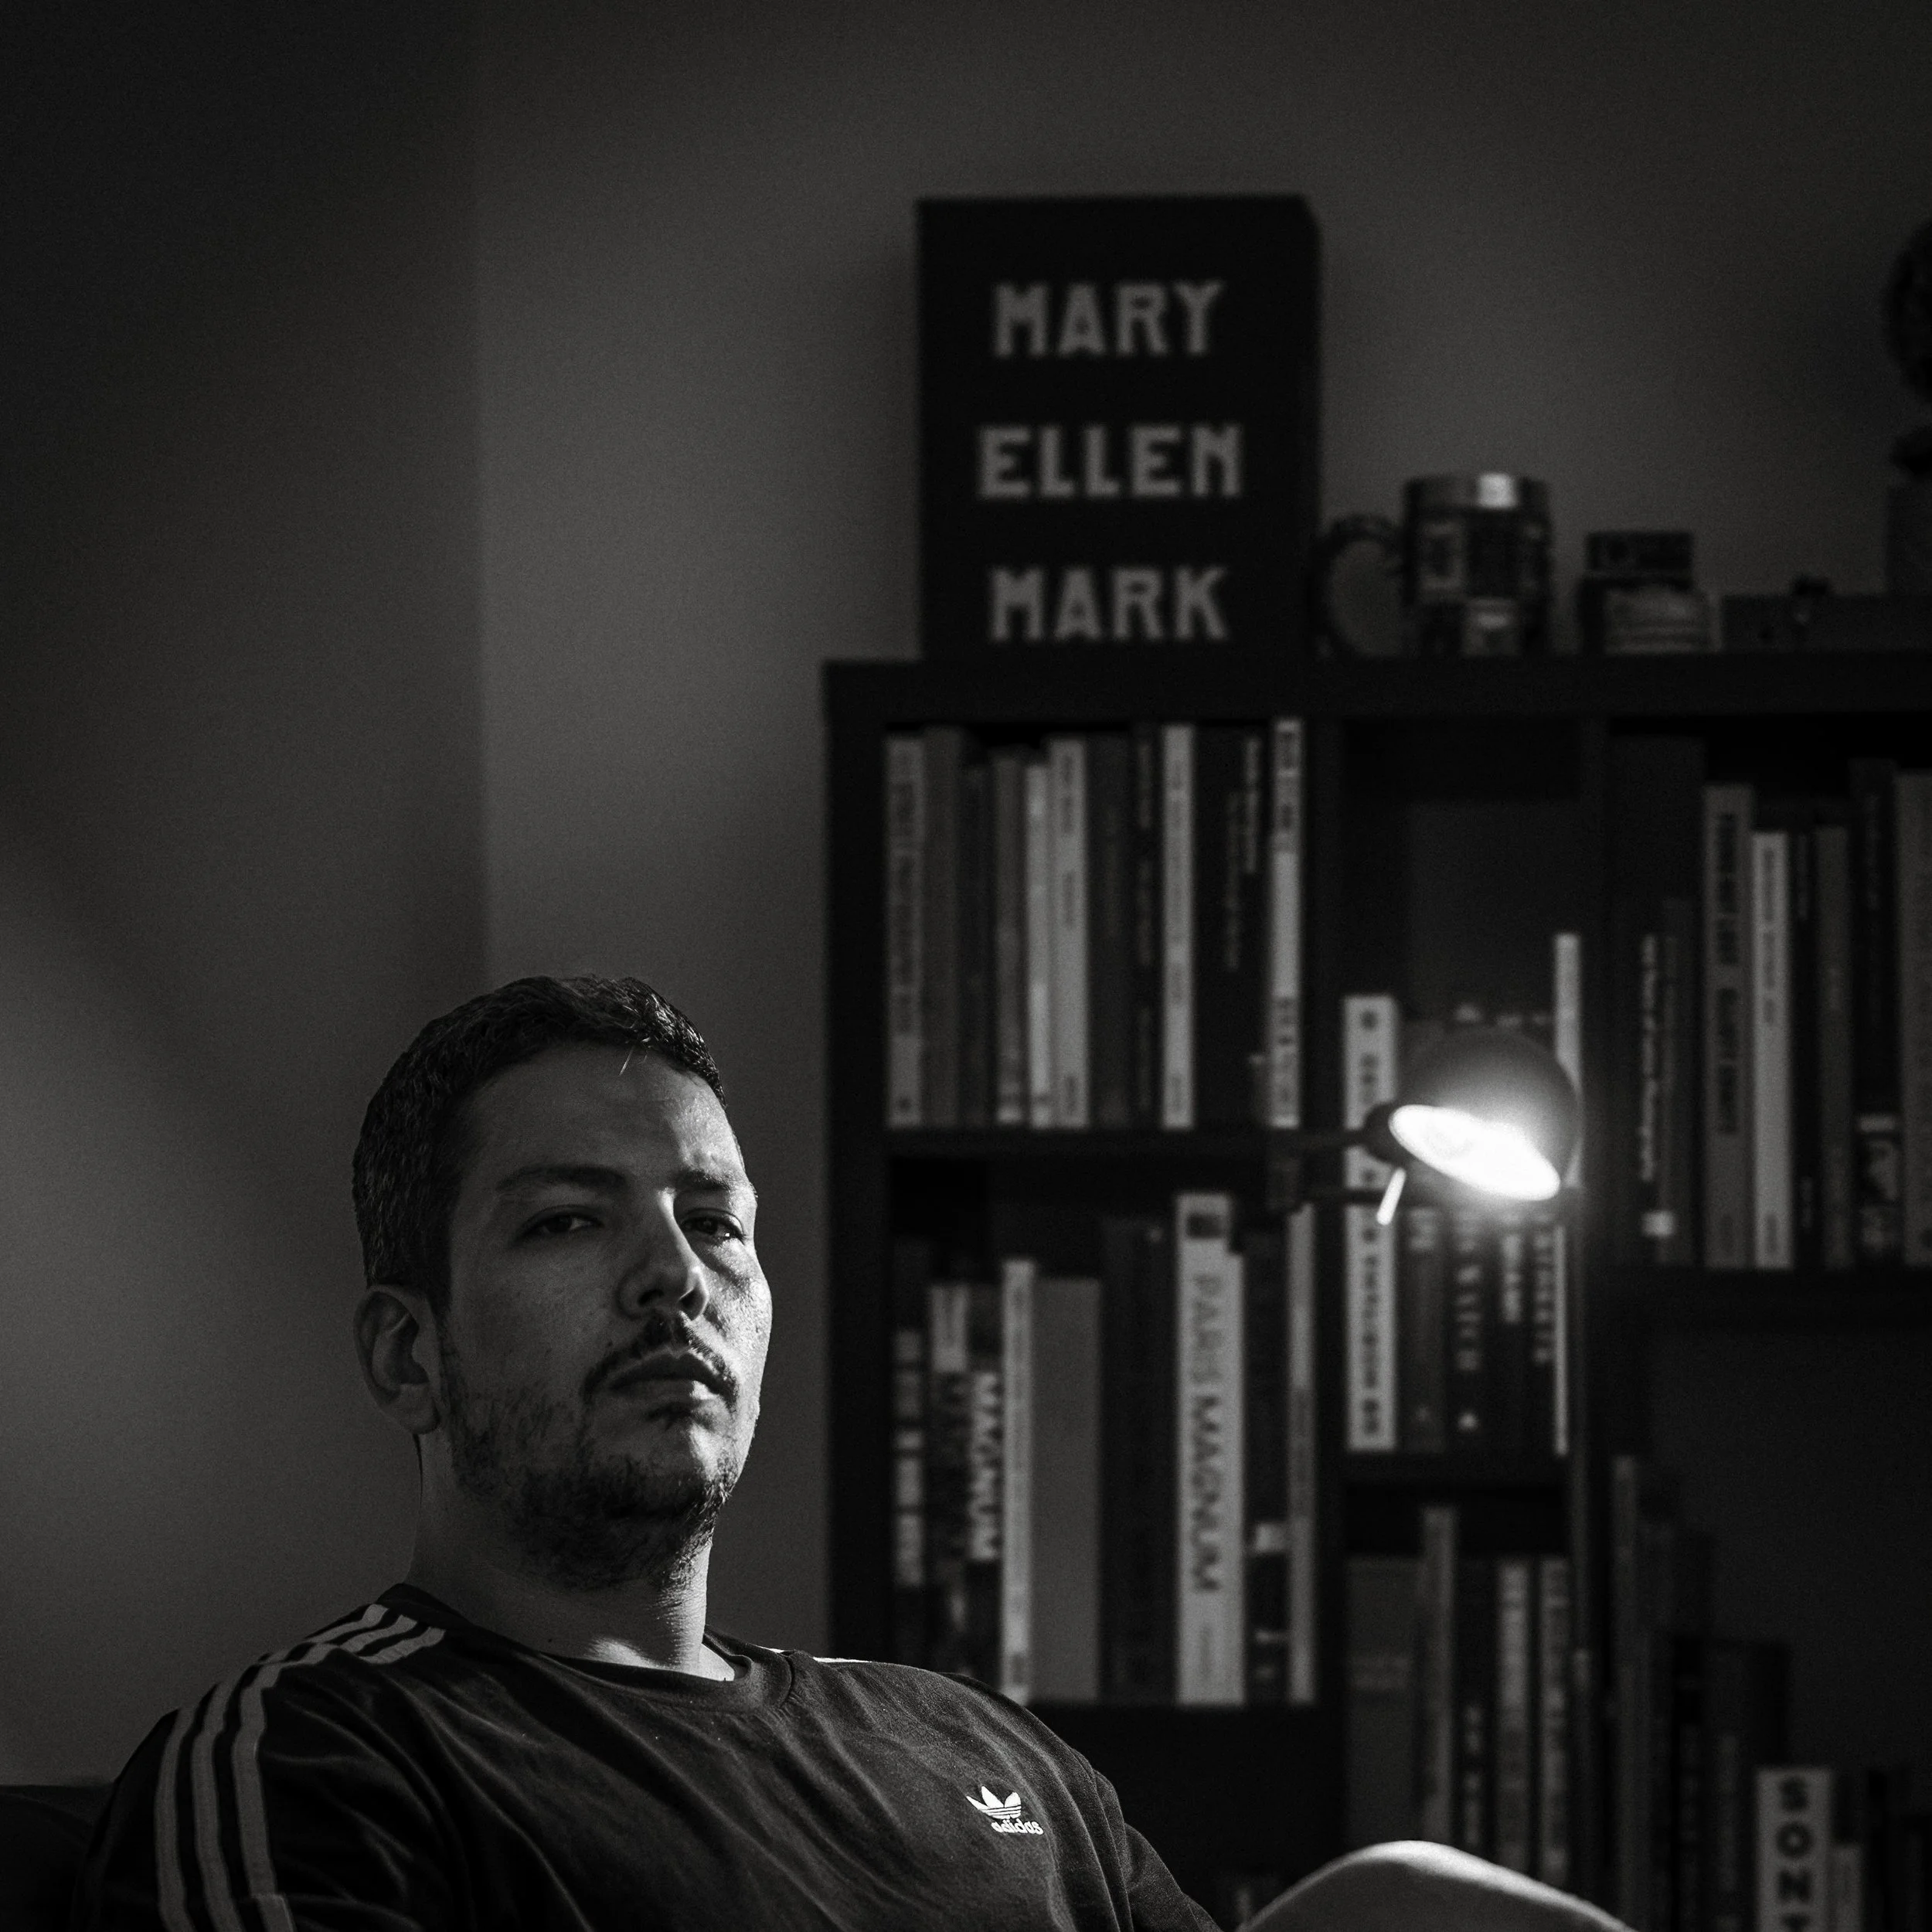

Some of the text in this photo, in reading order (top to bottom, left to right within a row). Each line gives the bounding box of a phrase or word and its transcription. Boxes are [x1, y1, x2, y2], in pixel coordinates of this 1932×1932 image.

[992, 279, 1226, 358] MARY
[977, 423, 1243, 499] ELLEN
[989, 564, 1229, 644] MARK
[971, 1372, 998, 1560] MAGNUM
[1190, 1274, 1226, 1593] PARIS MAGNUM
[991, 1818, 1043, 1835] adidas
